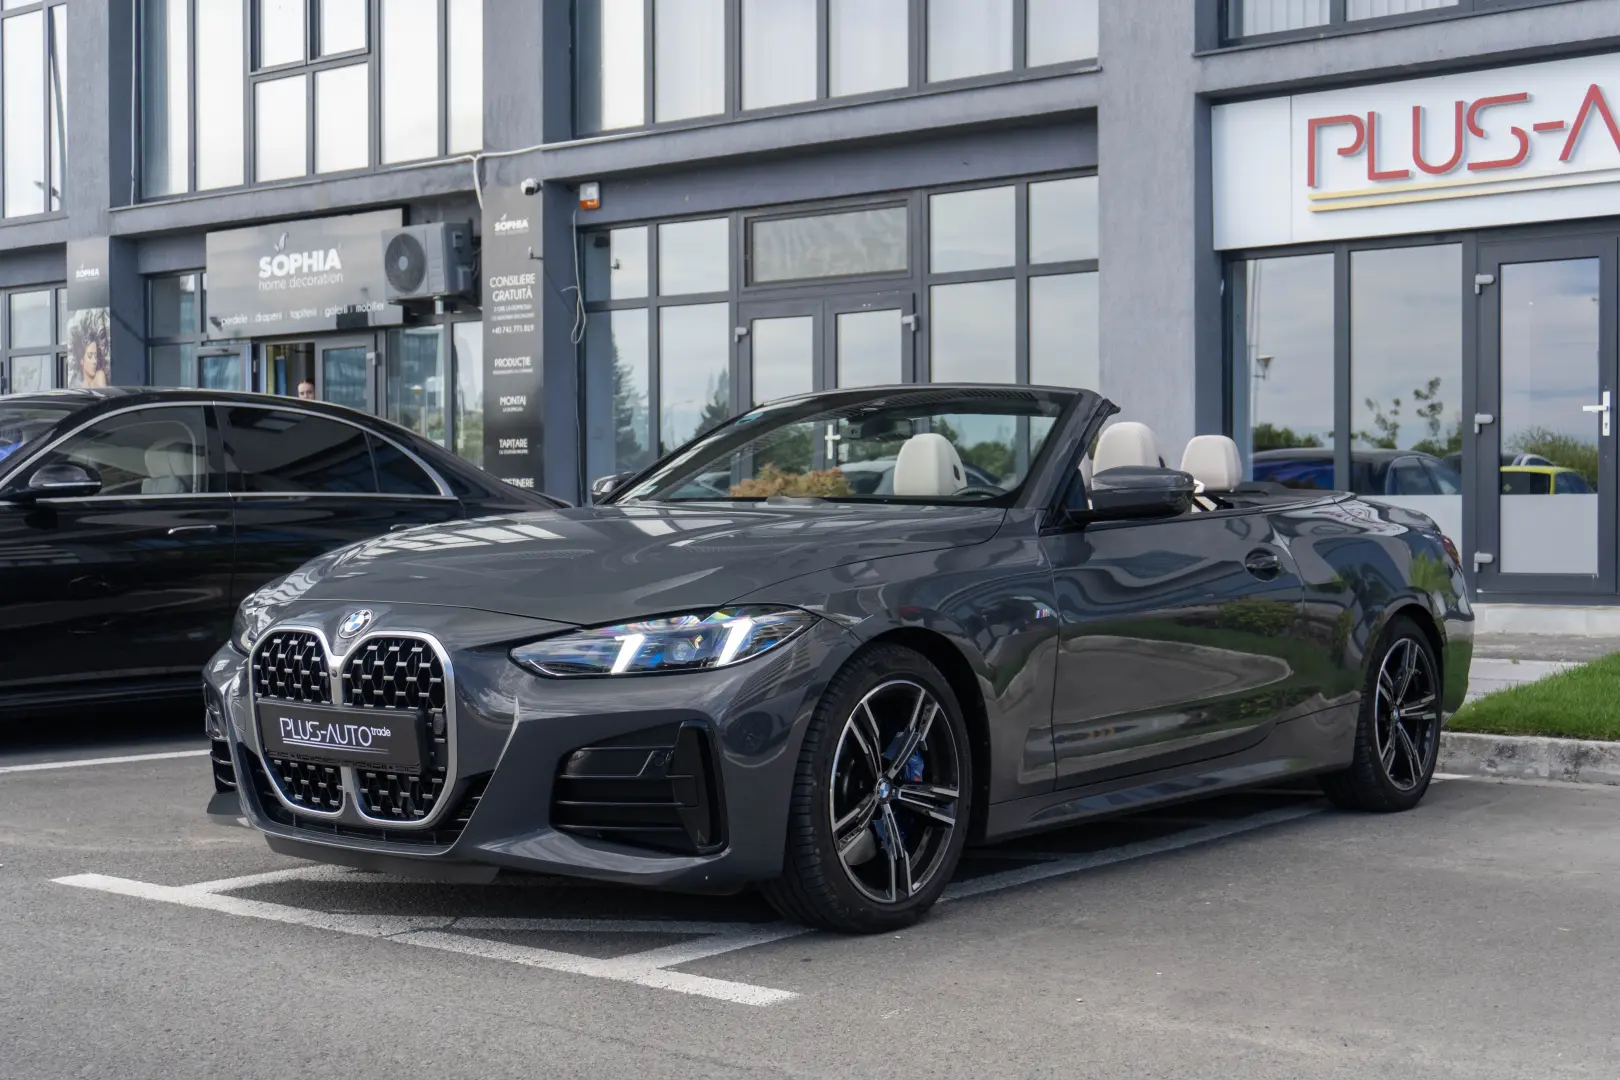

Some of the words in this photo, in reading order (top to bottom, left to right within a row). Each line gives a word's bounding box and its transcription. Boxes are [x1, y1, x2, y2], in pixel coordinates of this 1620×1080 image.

[494, 219, 529, 231] SOPHIA
[258, 248, 342, 278] SOPHIA
[75, 268, 100, 278] SOPHIA
[258, 280, 287, 291] home
[288, 272, 344, 288] decoration
[499, 395, 527, 406] MONTAJ
[279, 717, 372, 747] PLUS-AUTO
[370, 726, 391, 737] trade
